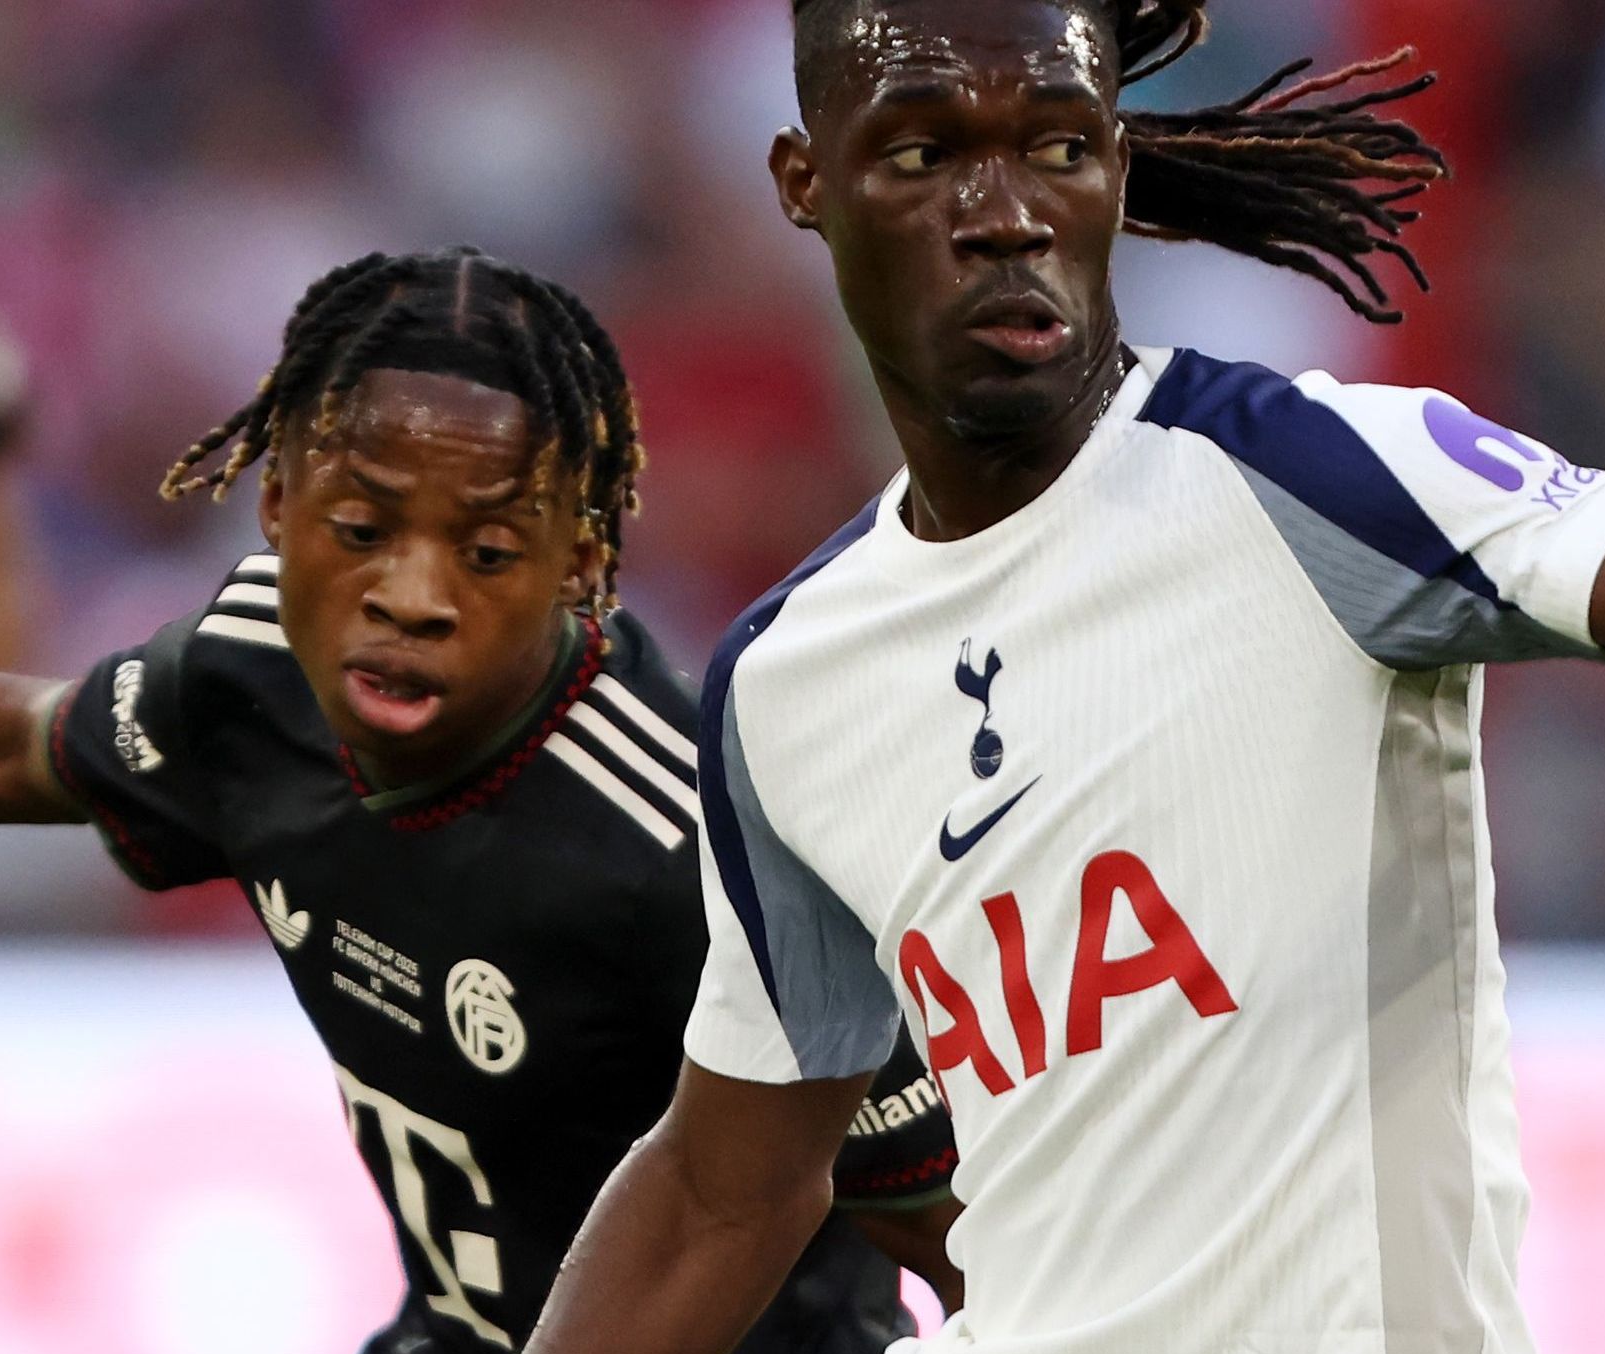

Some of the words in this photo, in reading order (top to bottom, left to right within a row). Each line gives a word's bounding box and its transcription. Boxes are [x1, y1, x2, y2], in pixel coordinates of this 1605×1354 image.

[332, 936, 345, 953] FC
[345, 942, 380, 973] BAYERN
[336, 919, 377, 951] TELEKOM
[377, 941, 395, 962] CUP
[394, 952, 419, 977] 2025
[899, 849, 1239, 1118] AIA
